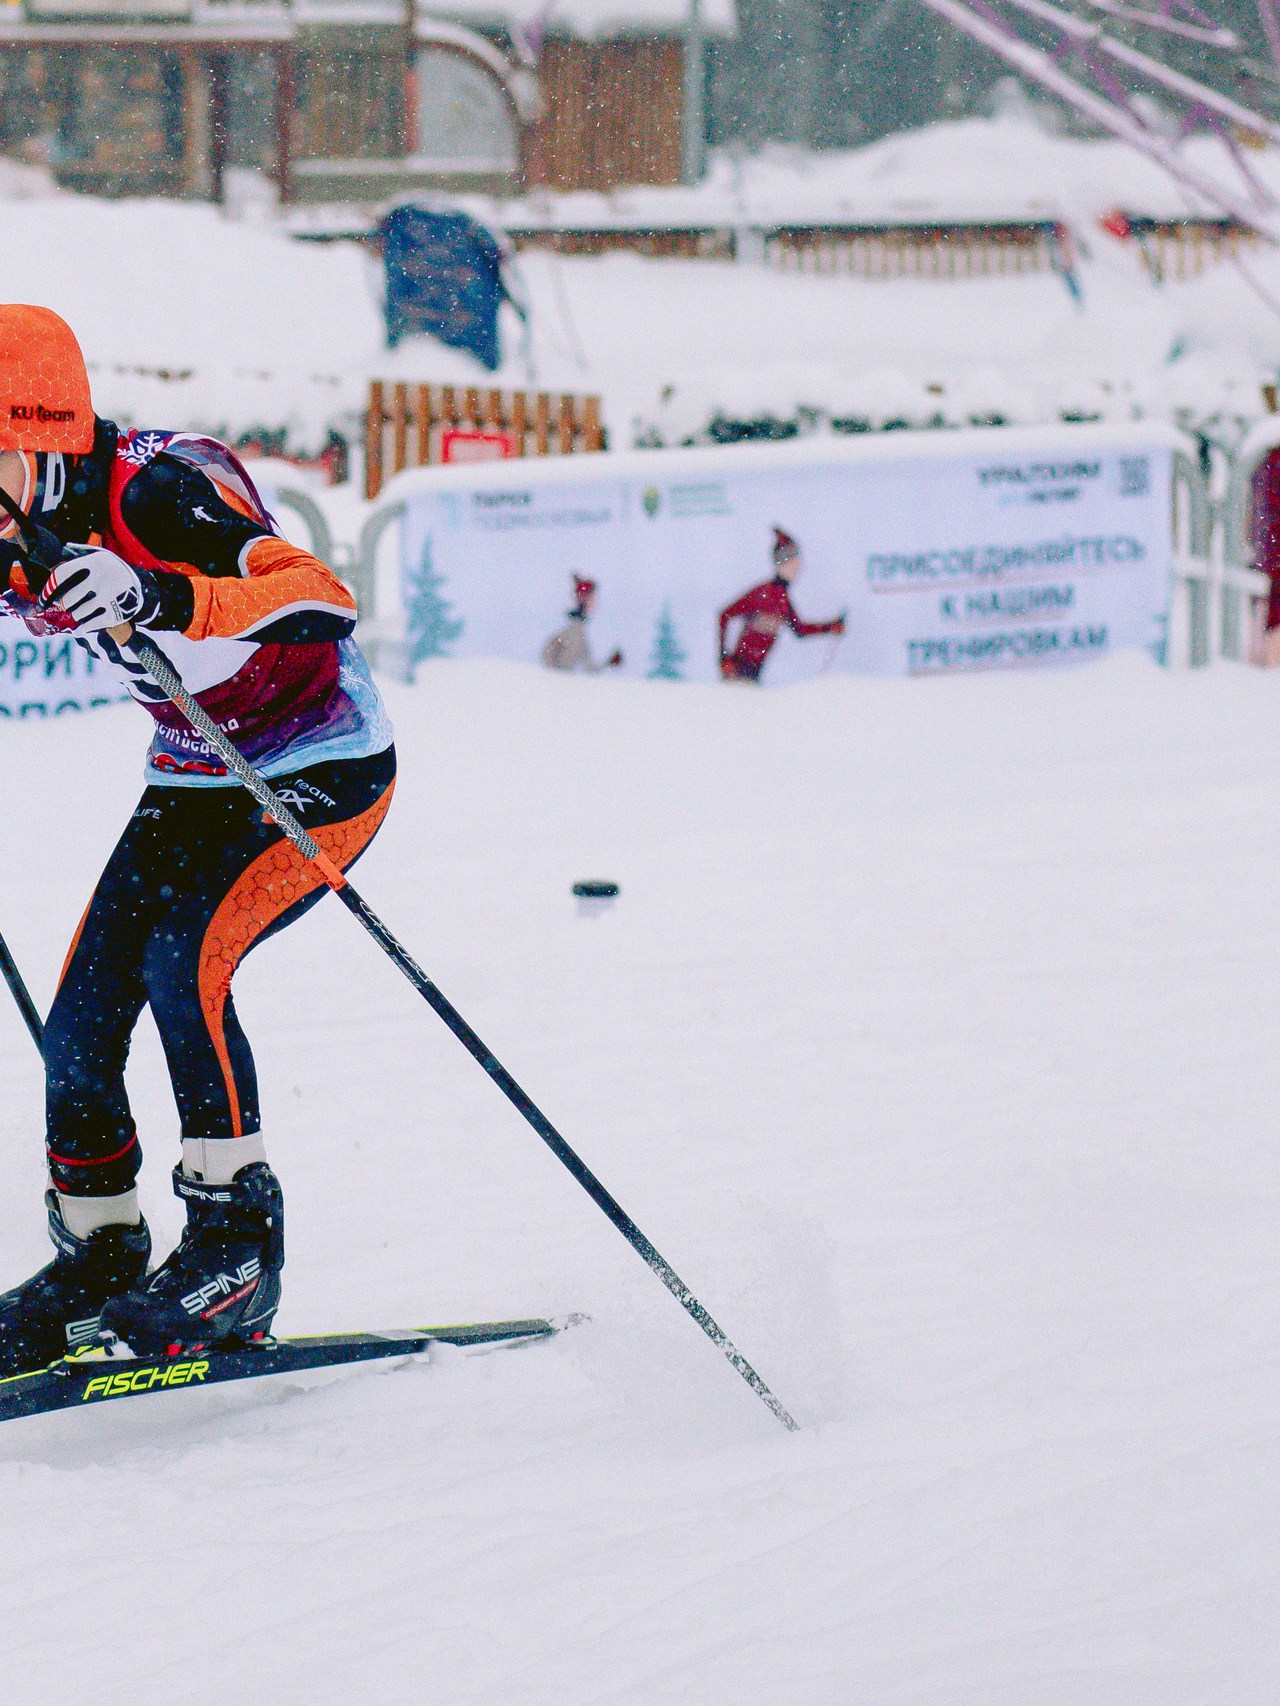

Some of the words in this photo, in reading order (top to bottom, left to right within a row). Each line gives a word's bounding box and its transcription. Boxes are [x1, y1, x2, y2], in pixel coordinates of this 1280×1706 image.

[11, 405, 34, 420] KU
[36, 404, 75, 423] team
[178, 1183, 232, 1202] SPINE
[180, 1257, 261, 1315] SPINE
[82, 1360, 209, 1401] FISCHER
